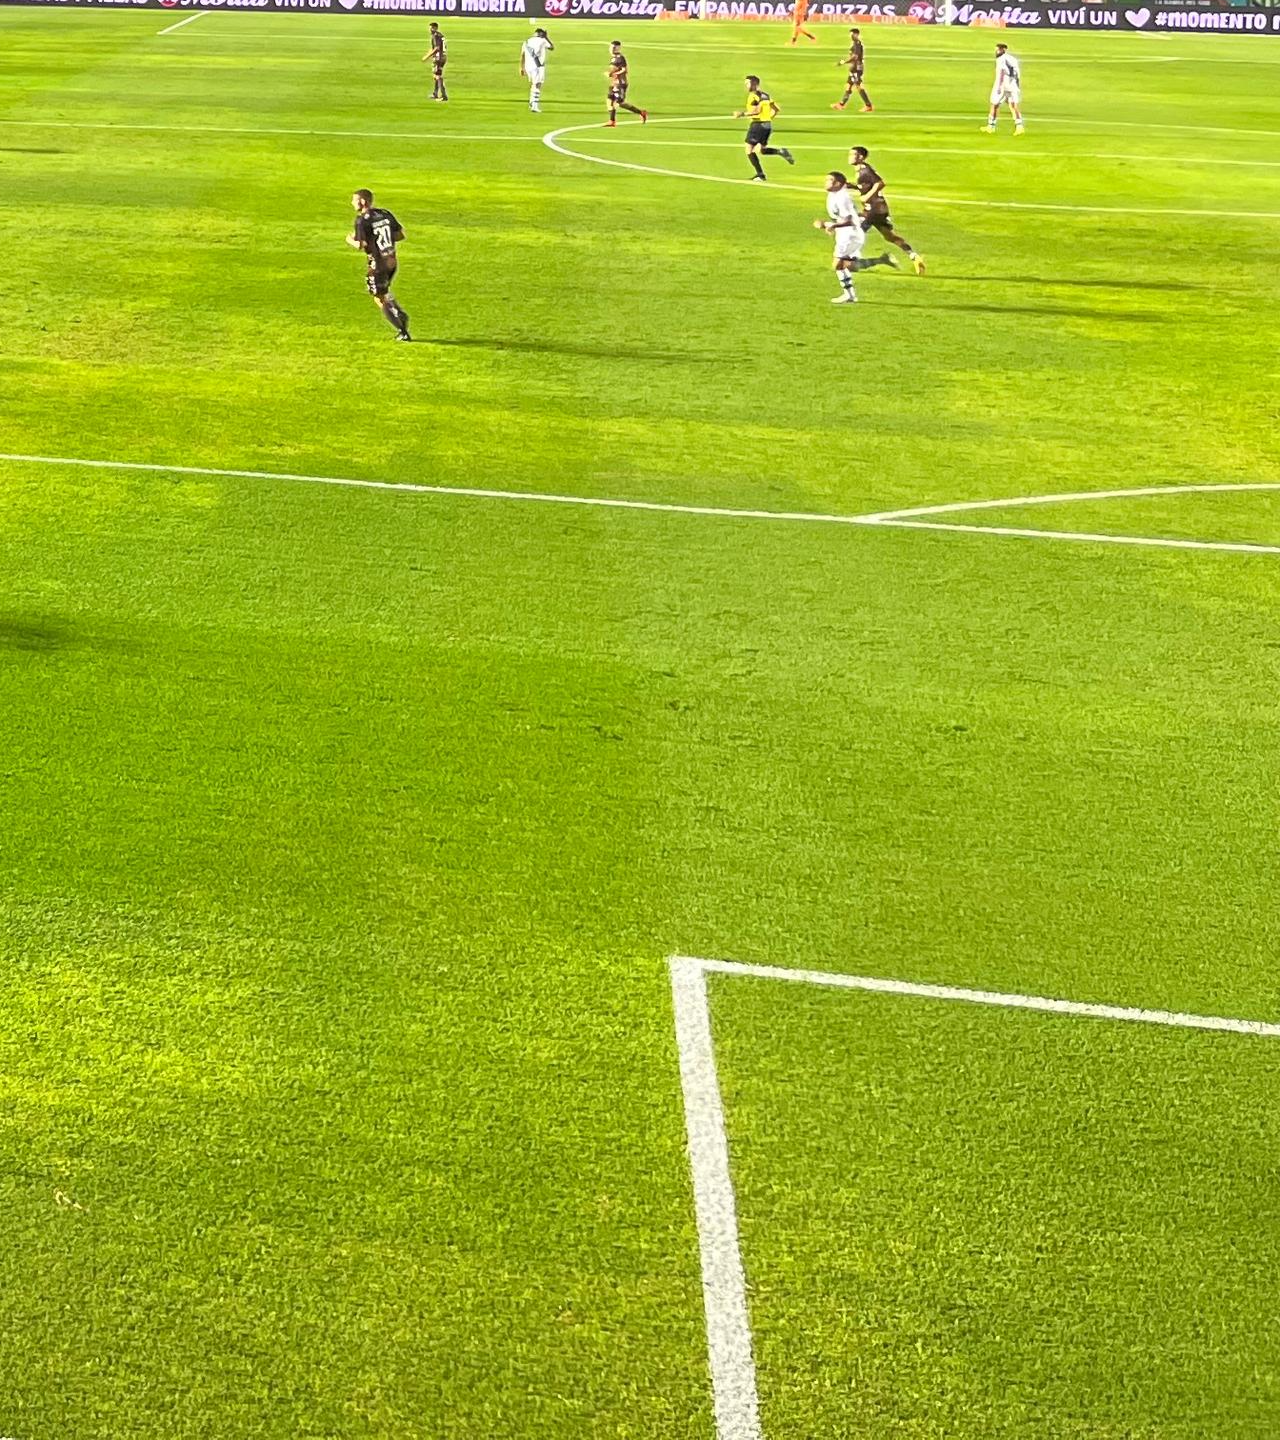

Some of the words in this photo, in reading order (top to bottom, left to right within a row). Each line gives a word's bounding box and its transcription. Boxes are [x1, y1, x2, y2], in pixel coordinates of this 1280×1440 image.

[1048, 6, 1086, 26] VIVÍ
[1089, 10, 1118, 26] UN
[372, 224, 393, 251] 20
